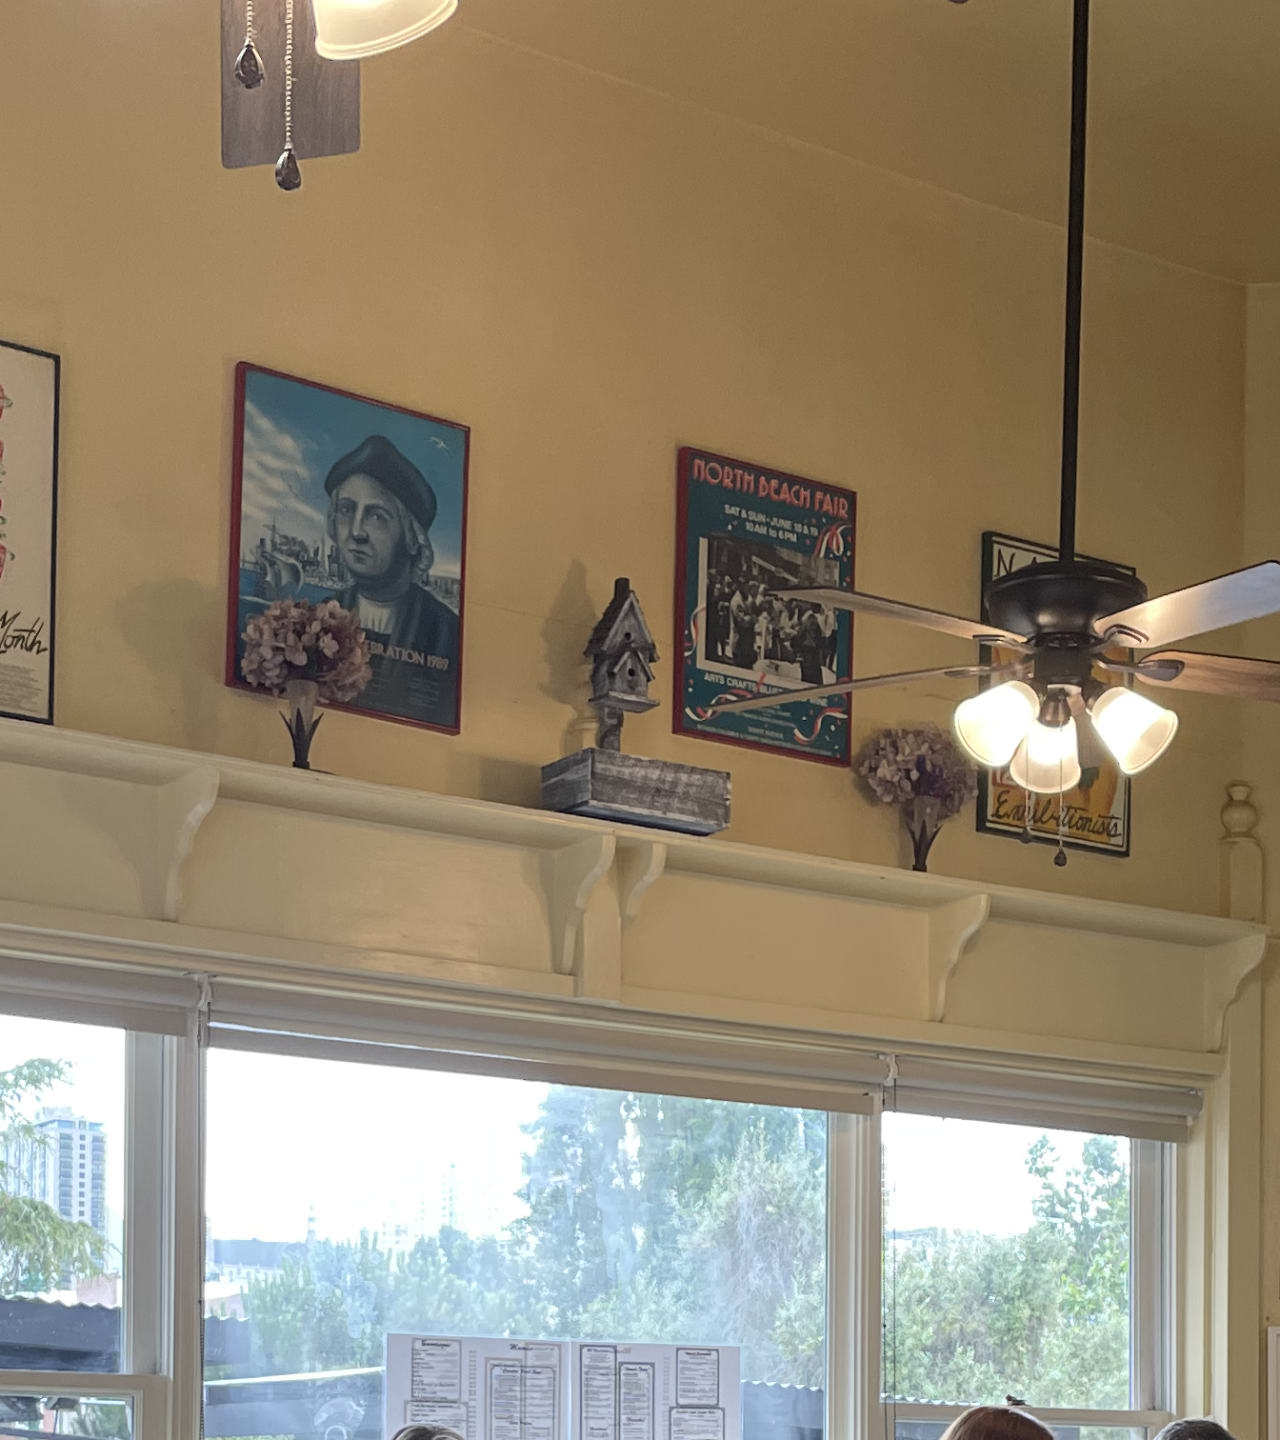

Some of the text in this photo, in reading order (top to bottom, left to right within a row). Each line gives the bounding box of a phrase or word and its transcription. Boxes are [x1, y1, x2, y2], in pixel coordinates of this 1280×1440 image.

[692, 458, 849, 519] NORTH BEACH FAIR
[724, 503, 740, 516] SAT
[748, 510, 766, 523] SUN
[704, 671, 725, 685] ARTS
